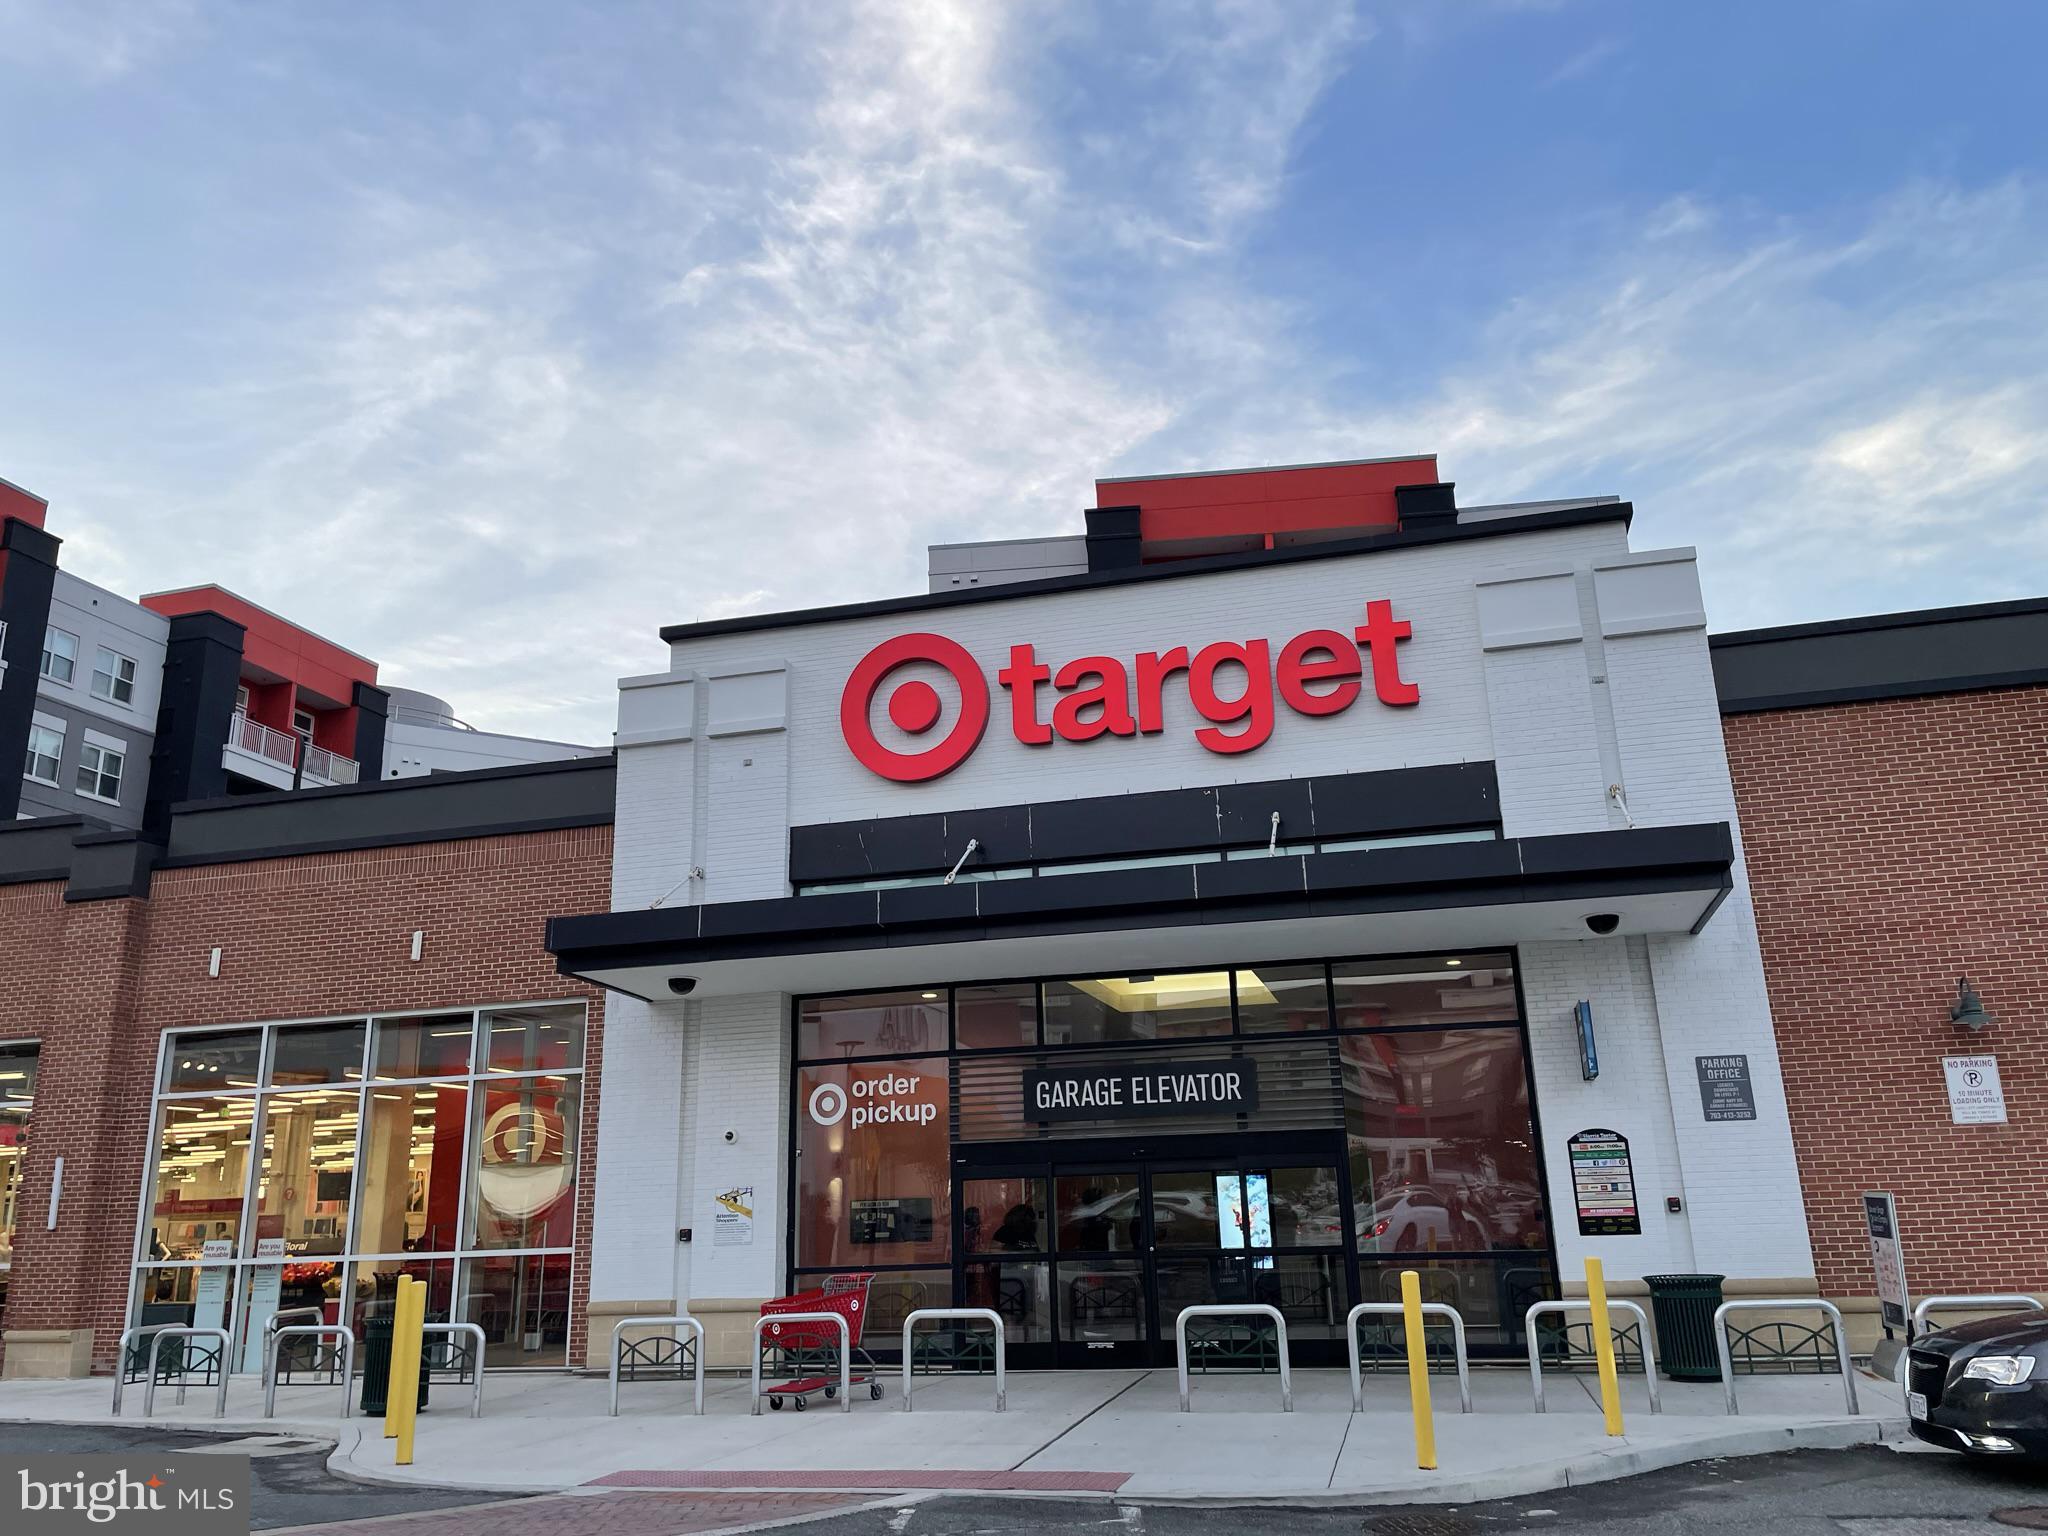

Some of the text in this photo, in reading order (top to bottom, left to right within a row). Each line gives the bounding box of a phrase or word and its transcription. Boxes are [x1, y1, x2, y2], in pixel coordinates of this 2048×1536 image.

[999, 599, 1420, 754] target
[1702, 1058, 1743, 1068] PARKING
[1948, 1060, 1993, 1069] NO PARKING
[1708, 1069, 1741, 1079] OFFICE
[852, 1073, 920, 1098] order
[1036, 1072, 1242, 1109] GARAGE ELEVATOR
[1983, 1096, 2000, 1104] ONLY
[852, 1100, 937, 1130] pickup
[270, 1243, 281, 1251] you
